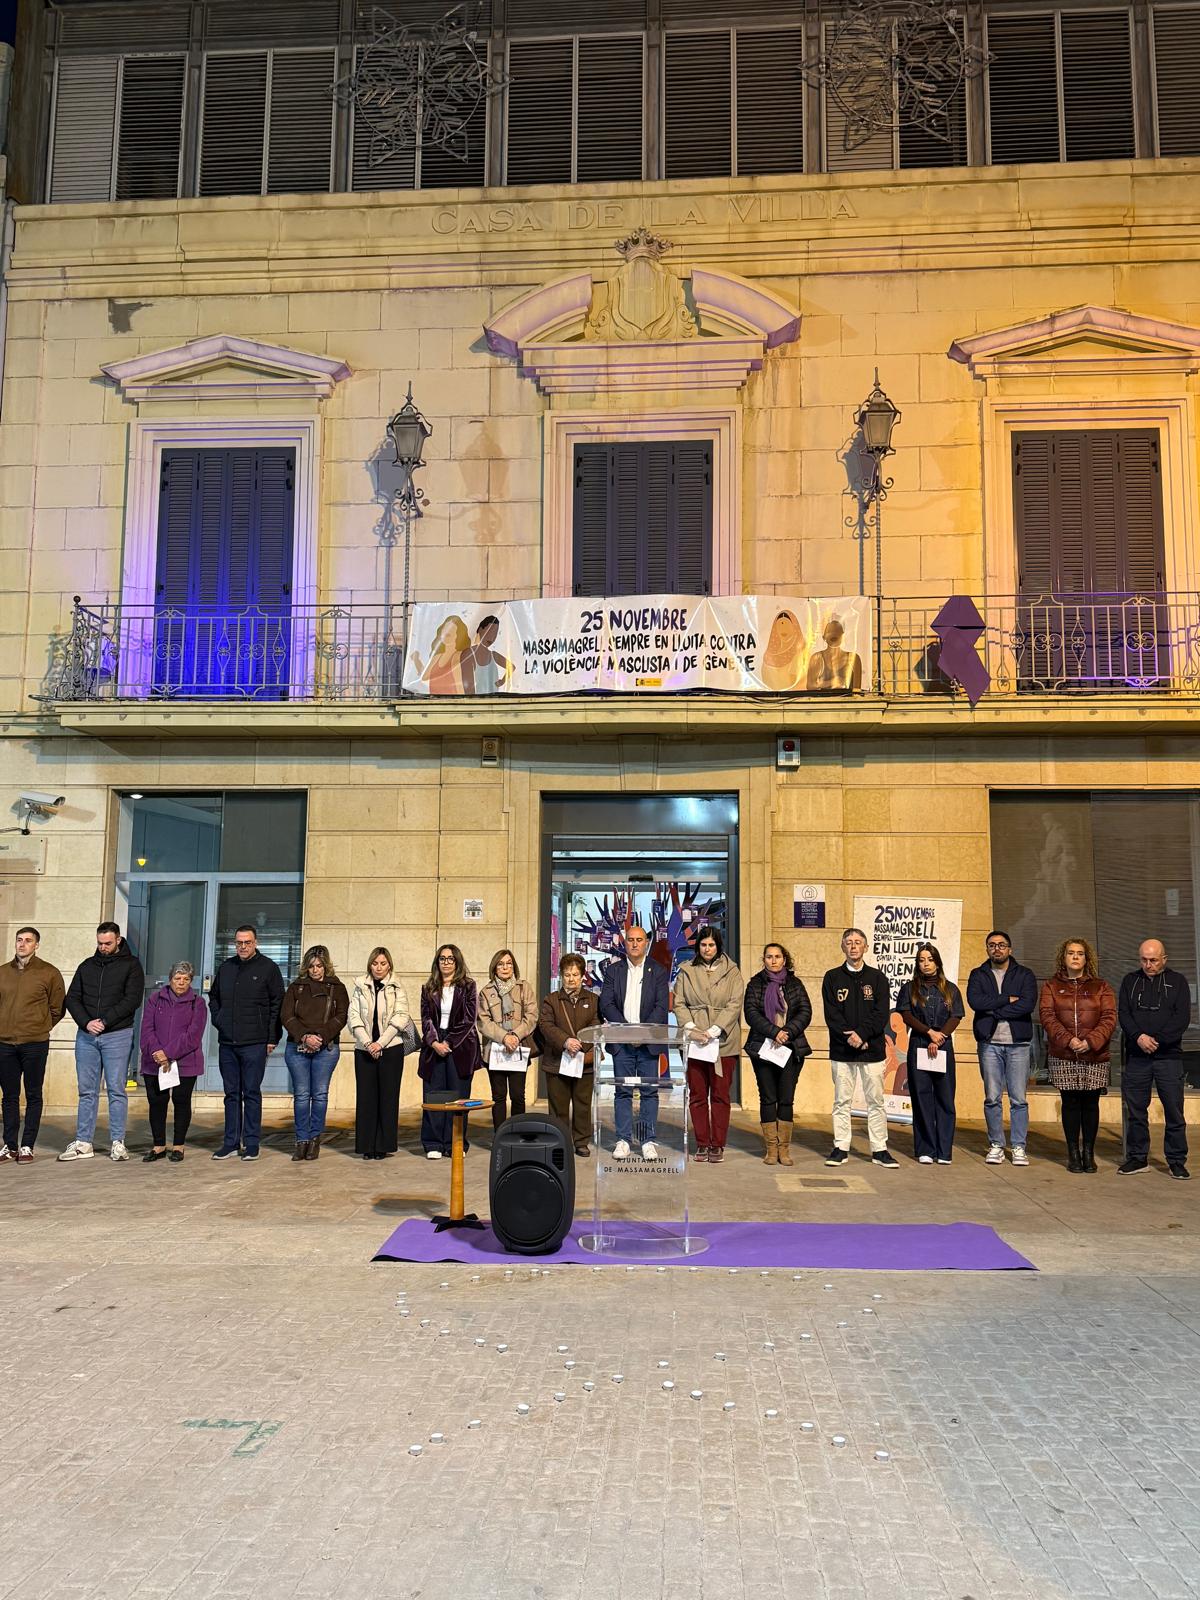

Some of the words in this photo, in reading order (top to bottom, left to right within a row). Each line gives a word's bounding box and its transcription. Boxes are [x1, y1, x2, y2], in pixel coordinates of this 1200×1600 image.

[432, 205, 543, 234] CASA
[568, 204, 623, 230] DE
[651, 200, 708, 226] LA
[580, 610, 604, 633] 25
[609, 608, 687, 631] NOVEMBRE
[608, 633, 650, 652] SEMPRE
[655, 635, 668, 650] EN
[672, 633, 706, 652] LLUITA
[710, 633, 756, 652] CONTRA
[525, 659, 539, 674] LA
[543, 655, 602, 674] VIOLÈNCIA
[675, 658, 678, 670] I
[683, 655, 697, 673] DE
[874, 921, 937, 940] MASSAMAGRELL
[873, 943, 891, 954] EN
[877, 959, 913, 977] VIOLÈN
[837, 988, 849, 1002] 67
